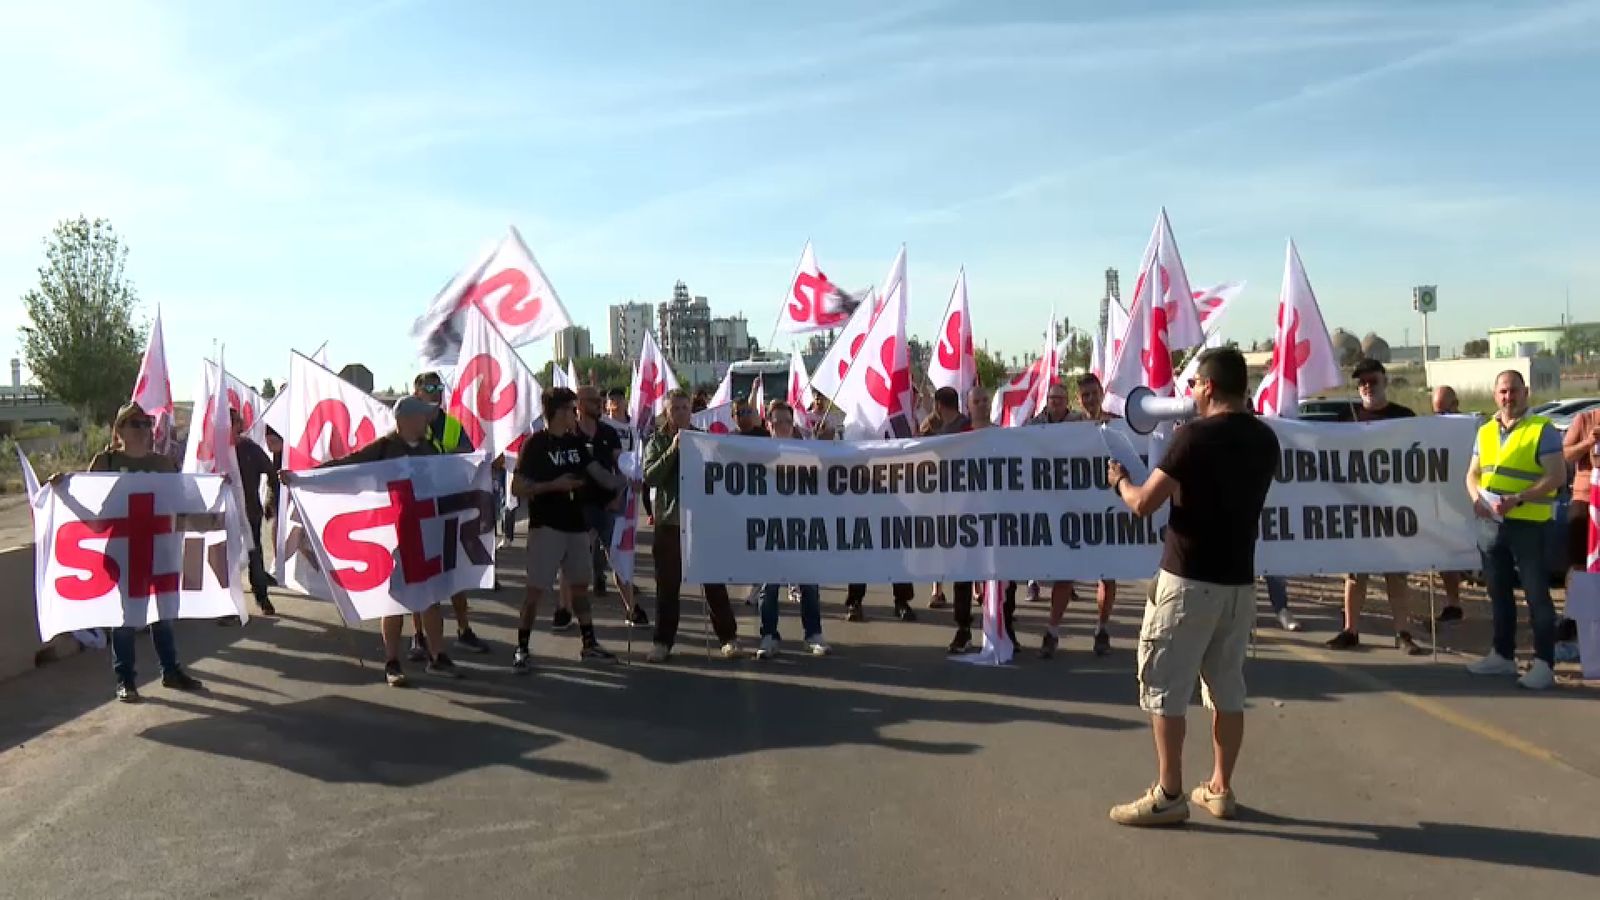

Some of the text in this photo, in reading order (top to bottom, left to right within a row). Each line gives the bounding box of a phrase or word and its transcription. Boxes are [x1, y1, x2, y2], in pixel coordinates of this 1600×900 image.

[704, 441, 1449, 496] POR UN COEFICIENTE REDU UBILACIÓN
[746, 505, 1418, 552] PARA LA INDUSTRIA QUÍMI EL REFINO
